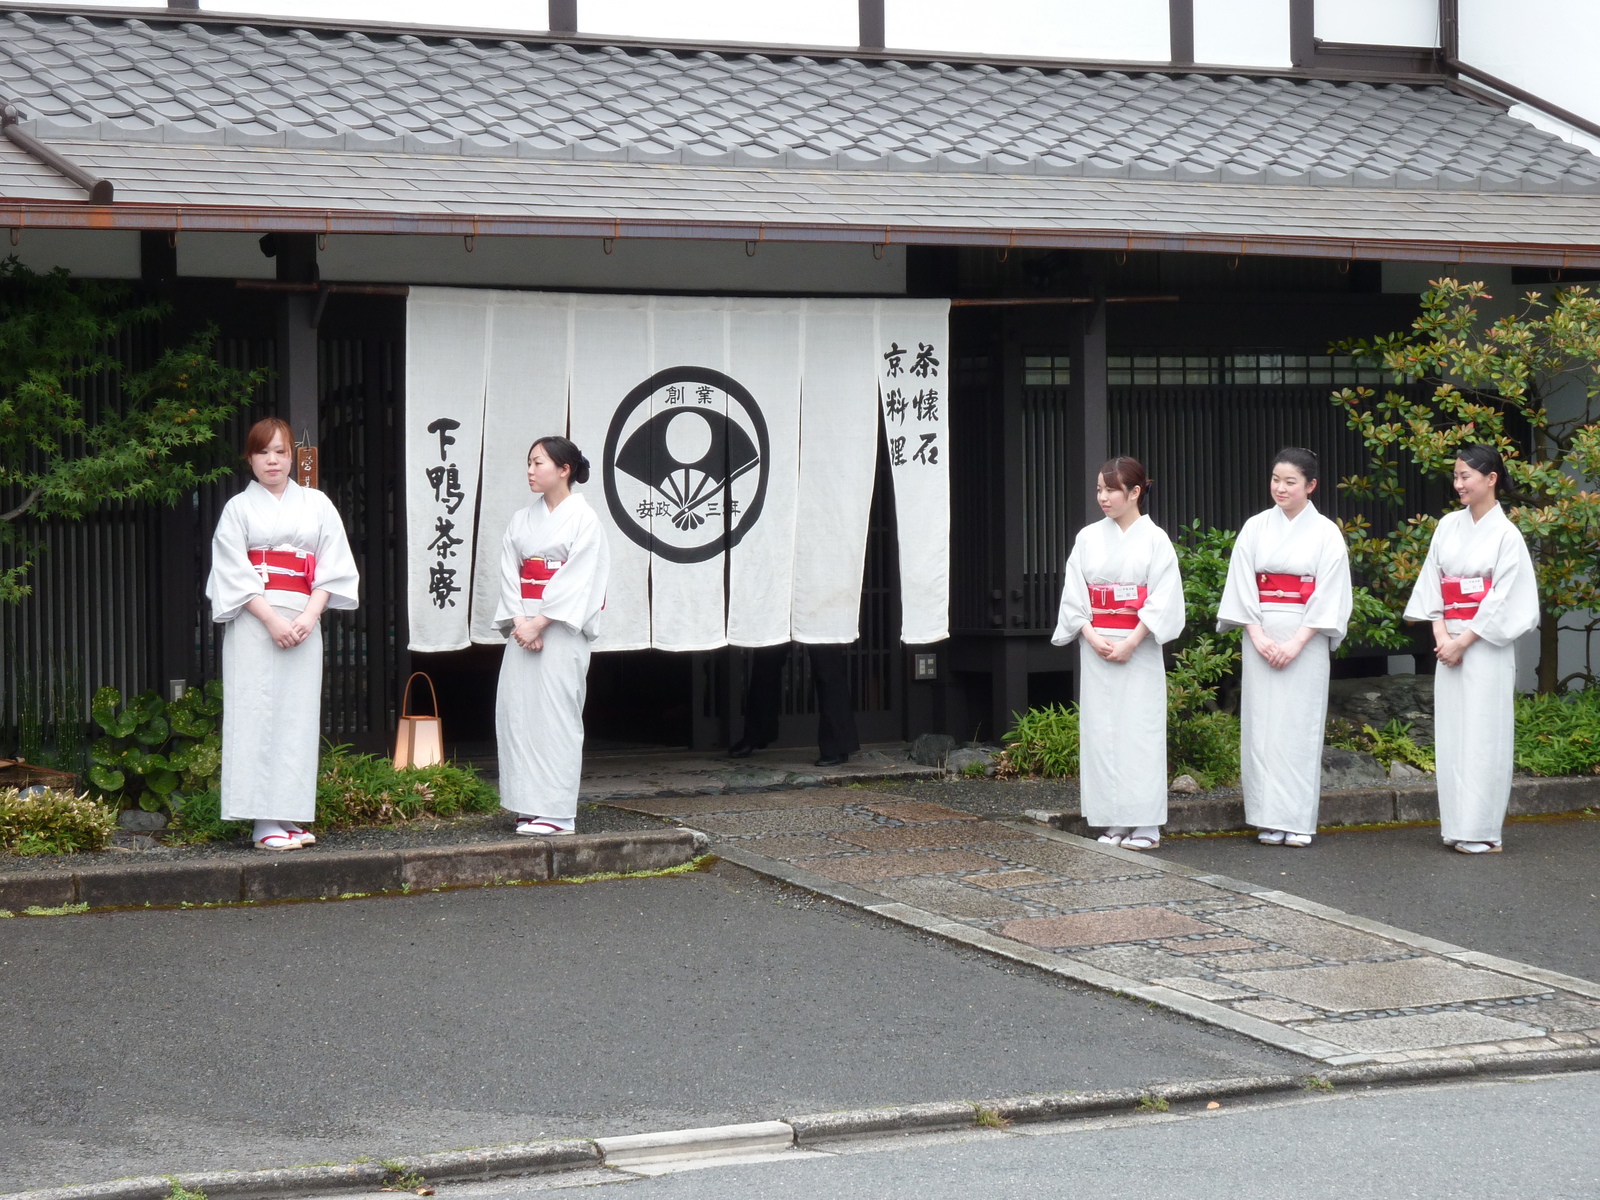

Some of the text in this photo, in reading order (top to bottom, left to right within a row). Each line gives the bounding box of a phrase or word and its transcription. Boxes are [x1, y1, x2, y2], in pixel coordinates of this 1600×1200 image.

[665, 385, 714, 404] 創業
[884, 341, 908, 467] 京料理
[909, 341, 940, 466] 茶懐石
[426, 418, 465, 609] 下鴨茶寮
[636, 499, 672, 519] 安政
